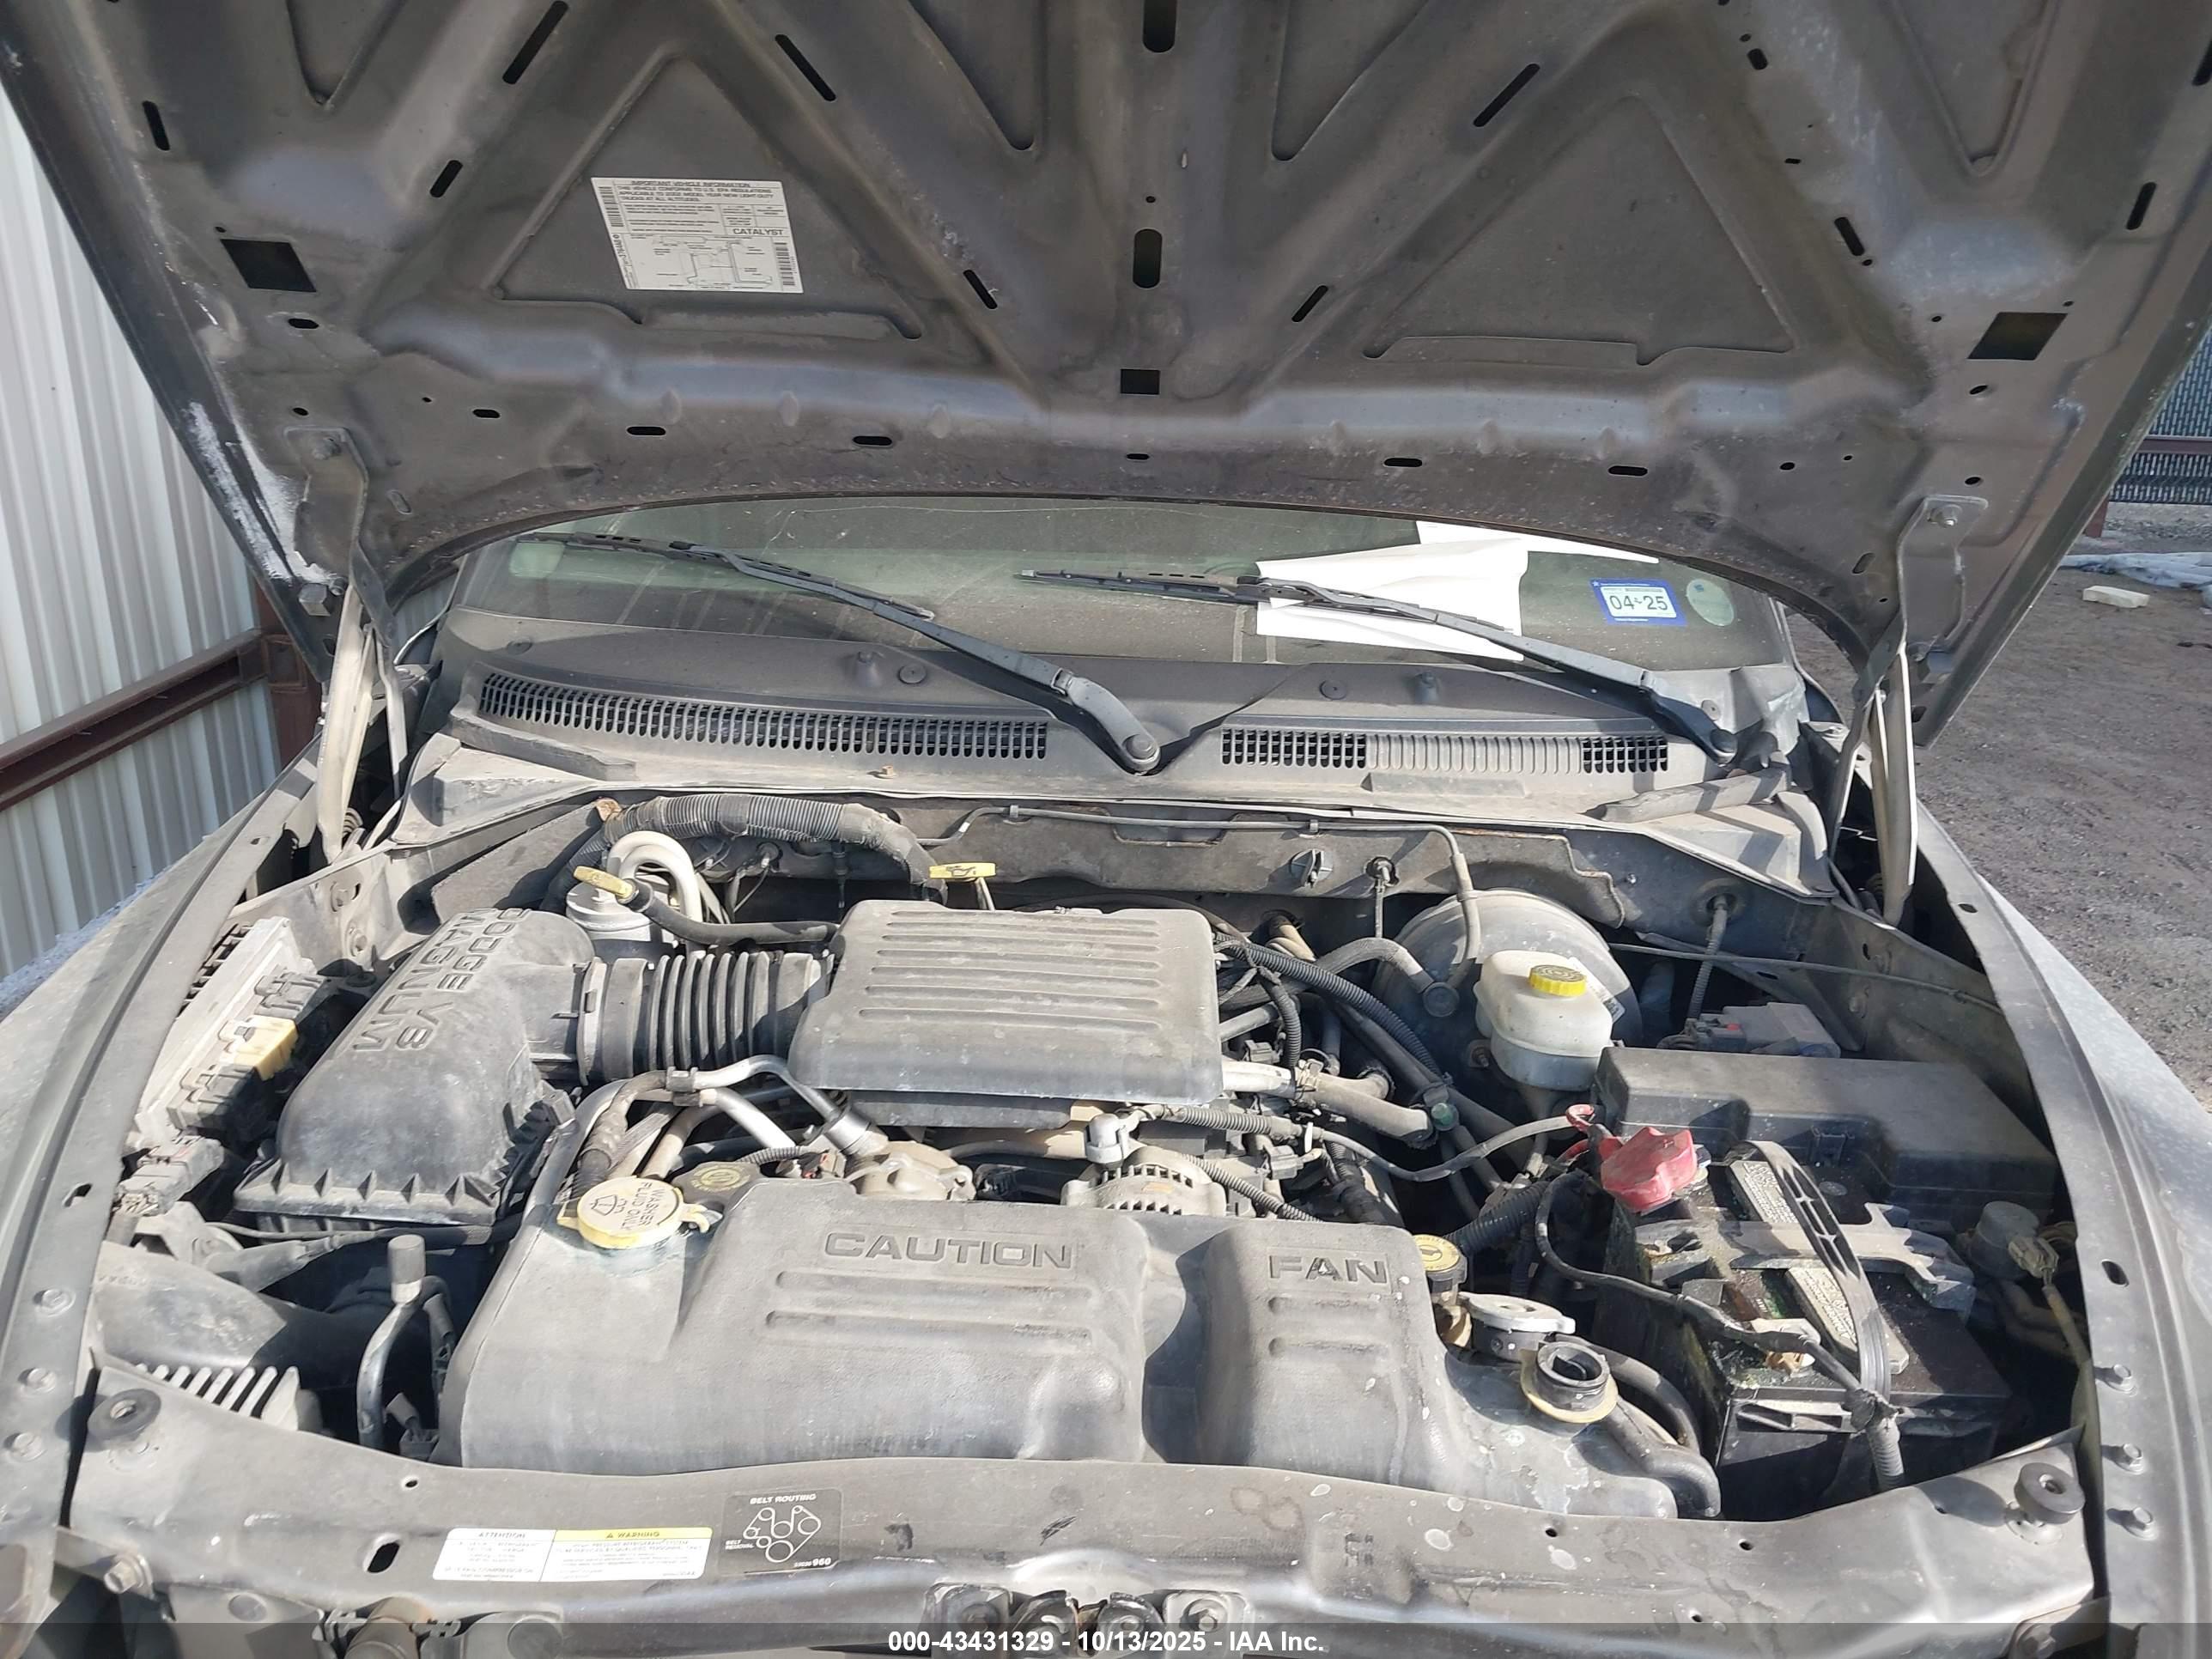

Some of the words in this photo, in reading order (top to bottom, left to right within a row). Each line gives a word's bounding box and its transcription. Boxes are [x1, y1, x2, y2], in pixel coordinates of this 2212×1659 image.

[437, 908, 531, 990] DODGE
[352, 908, 498, 1051] MAGNUM
[396, 1001, 454, 1049] V8
[824, 1231, 1072, 1269] CAUTION
[1269, 1255, 1388, 1285] FAN
[750, 1496, 774, 1504] BELT
[775, 1493, 817, 1503] ROUTING
